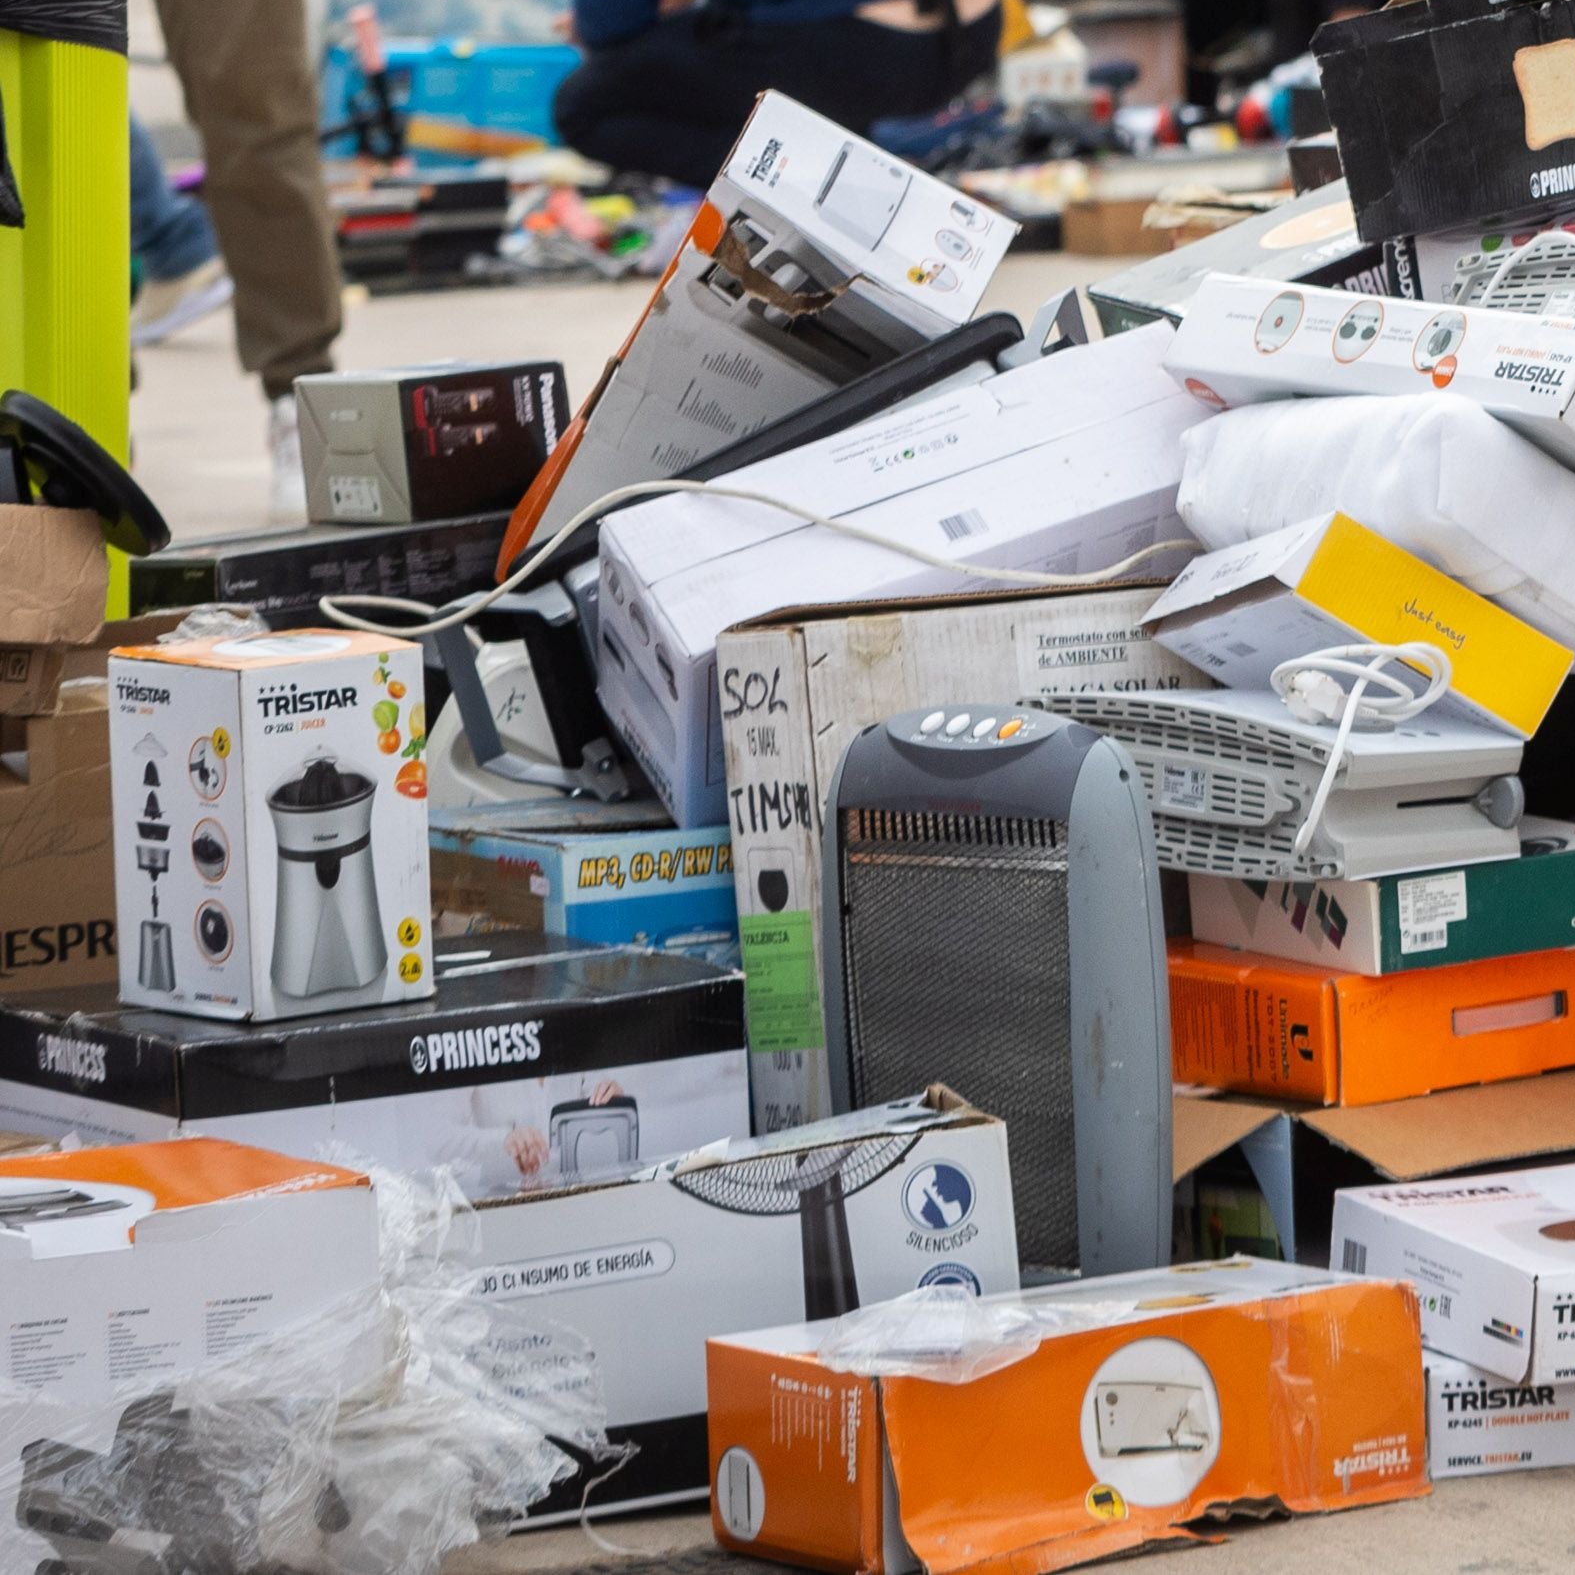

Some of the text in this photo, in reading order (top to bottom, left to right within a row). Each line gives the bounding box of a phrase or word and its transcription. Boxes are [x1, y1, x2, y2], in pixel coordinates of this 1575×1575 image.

[1037, 630, 1103, 647] Termostato
[1105, 627, 1126, 640] con
[1038, 645, 1128, 667] de AMBIENTE
[577, 855, 627, 889] MP3,
[2, 917, 115, 975] ESPR
[426, 1020, 543, 1073] PRINCESS
[905, 1222, 979, 1253] SILENCIOSO
[574, 1261, 592, 1278] DE
[596, 1247, 655, 1276] ENERGÍA
[1491, 1414, 1525, 1427] DOUBLE
[1545, 1409, 1571, 1423] PLATE
